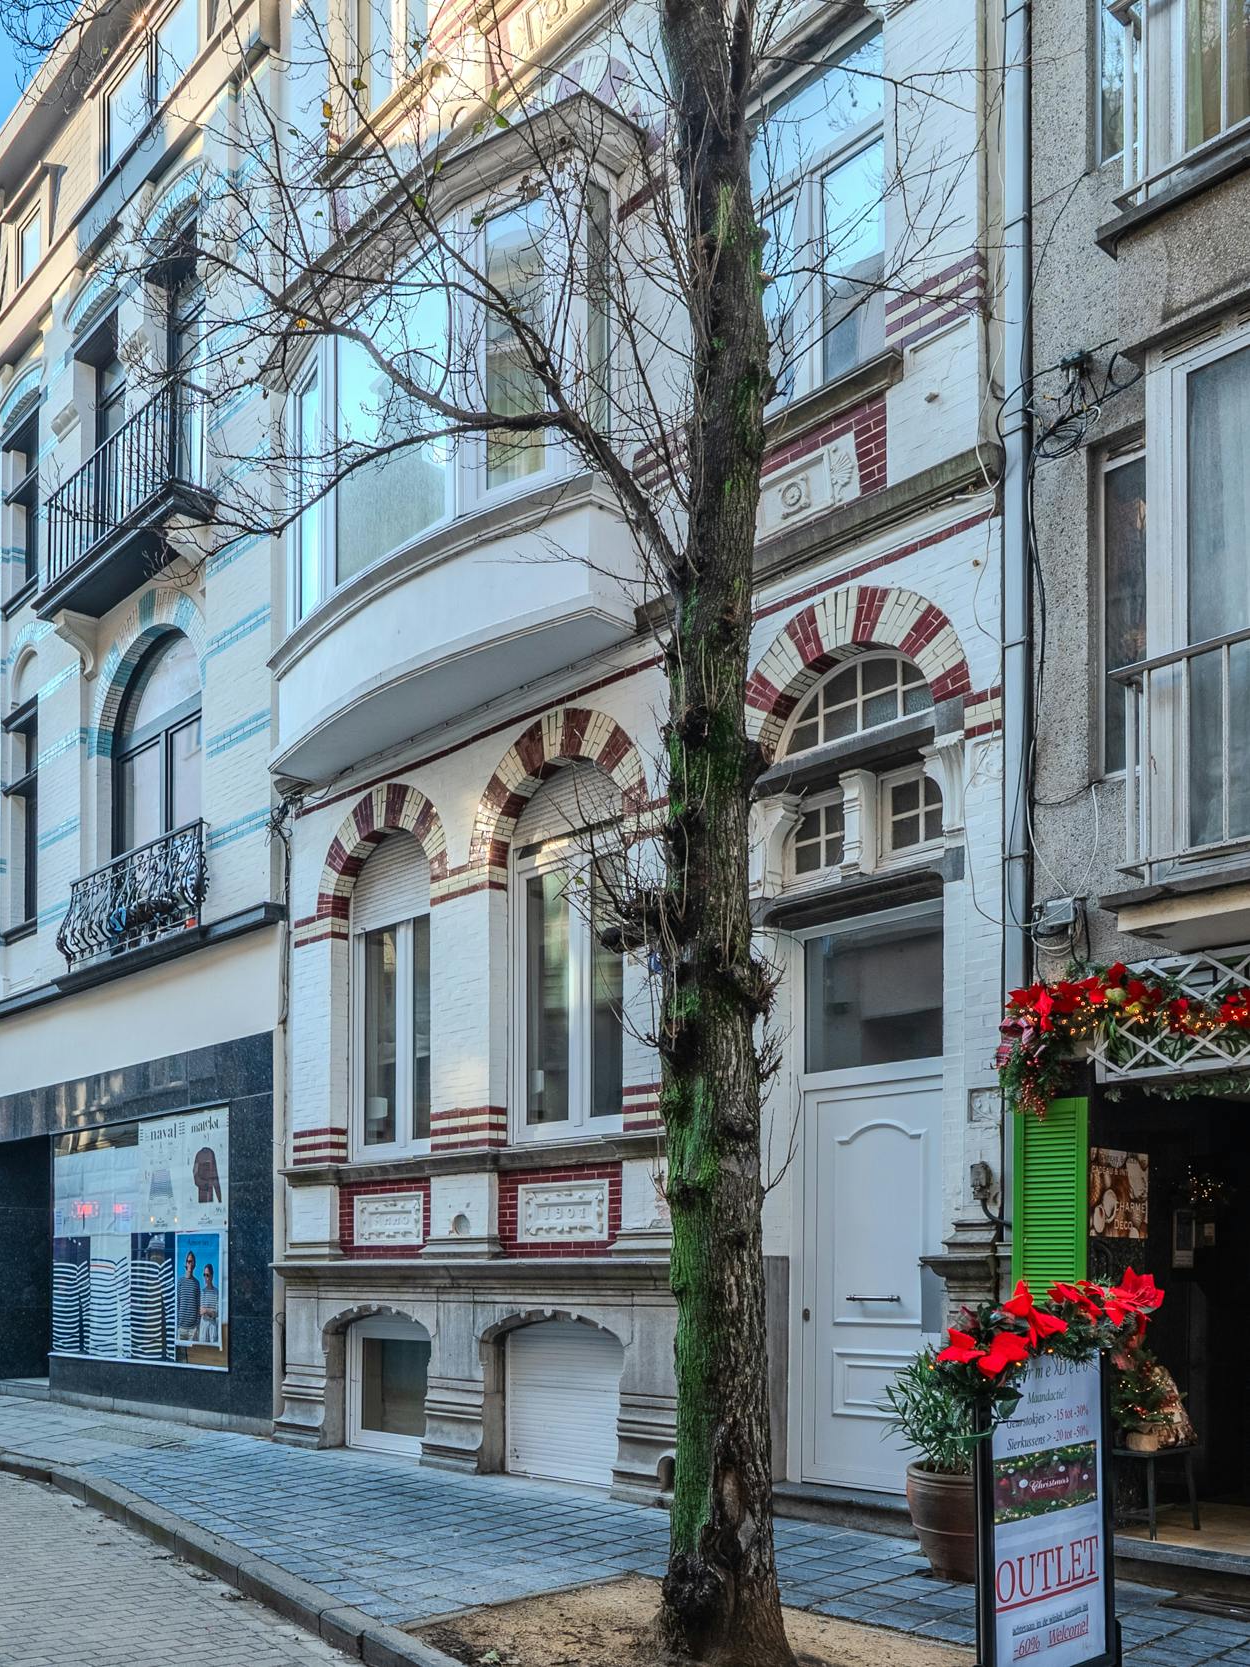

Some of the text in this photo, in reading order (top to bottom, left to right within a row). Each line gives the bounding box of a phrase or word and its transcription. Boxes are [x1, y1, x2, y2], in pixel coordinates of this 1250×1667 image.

[150, 1122, 177, 1141] naval
[1115, 1202, 1146, 1214] CHARME
[1027, 1386, 1067, 1404] Maandactie!
[1054, 1409, 1063, 1421] -15
[1064, 1410, 1073, 1420] tot
[1006, 1436, 1045, 1451] Sierkussens
[1053, 1429, 1064, 1441] -20
[1064, 1429, 1073, 1440] tot
[1030, 1477, 1069, 1493] Christmas
[996, 1535, 1099, 1603] OUTLET
[1013, 1614, 1089, 1656] -60% Welcome!
